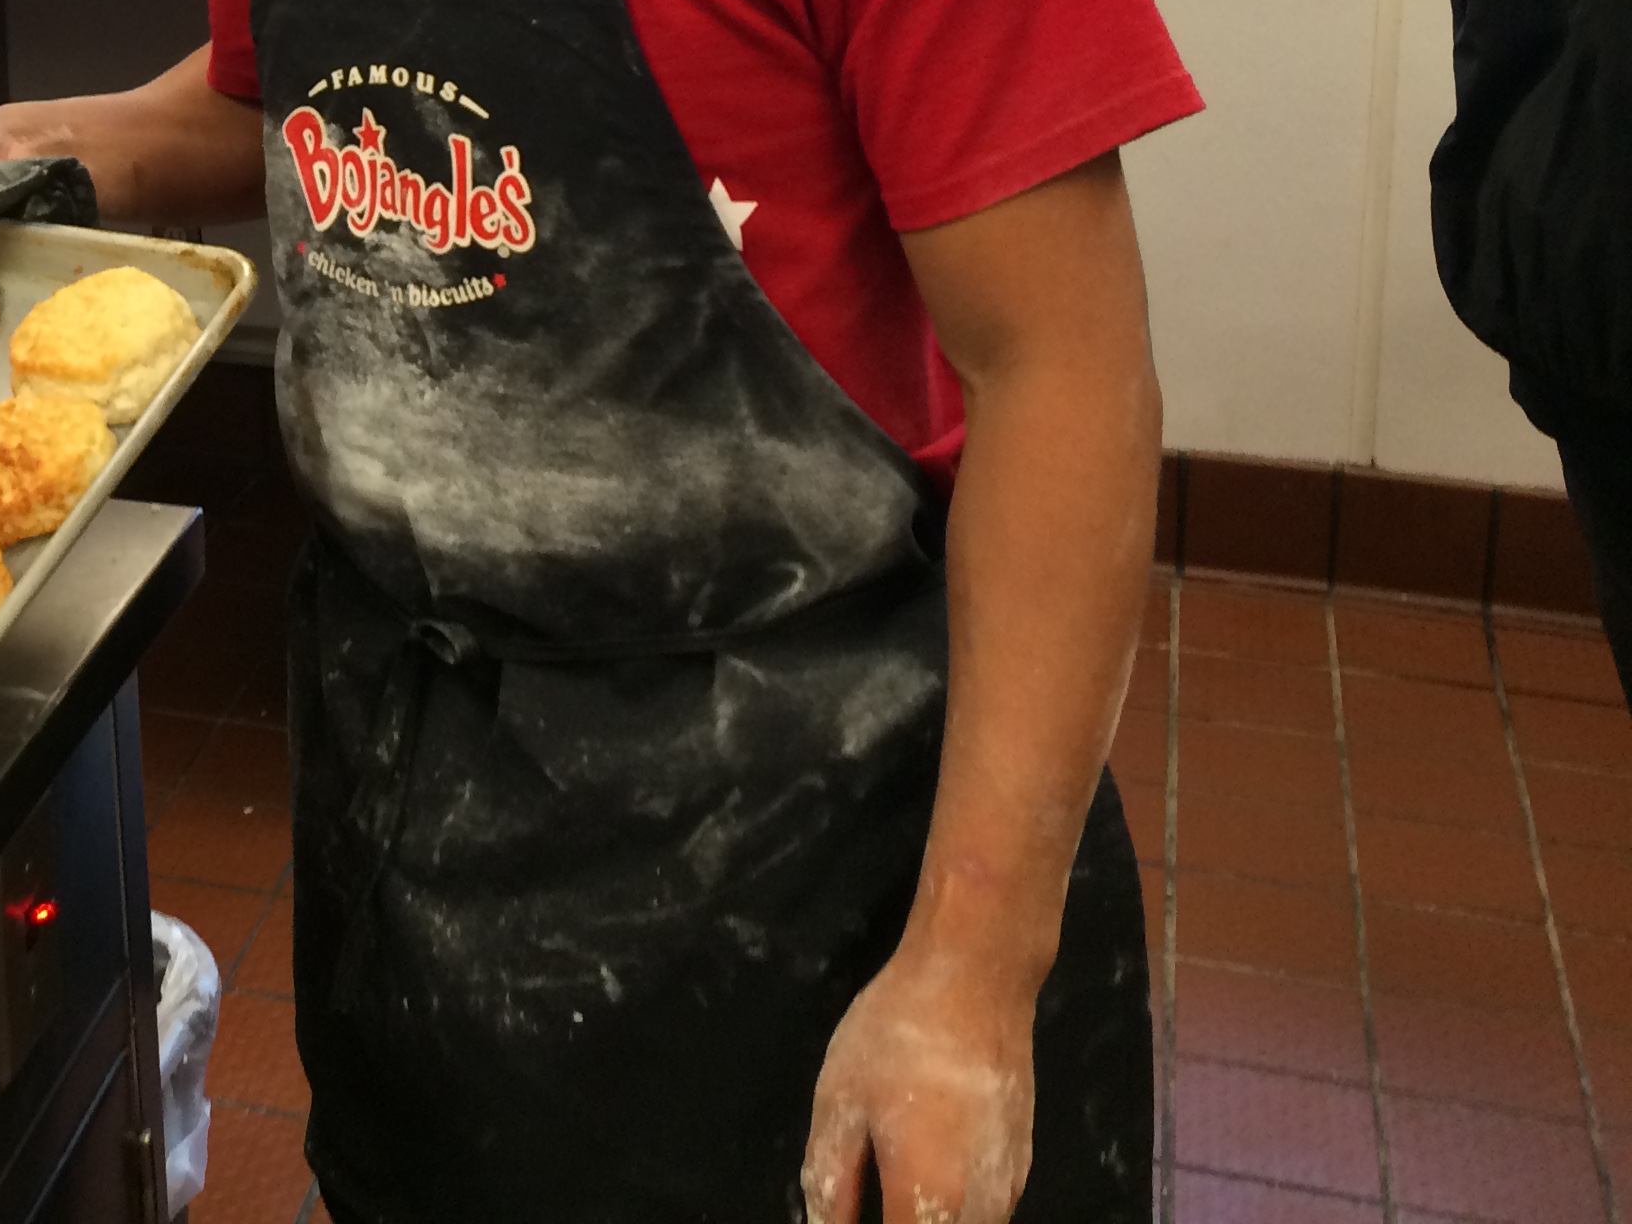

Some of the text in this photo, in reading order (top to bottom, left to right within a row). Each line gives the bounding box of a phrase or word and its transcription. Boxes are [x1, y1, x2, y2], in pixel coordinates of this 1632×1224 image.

[330, 64, 459, 102] FAMOUS
[308, 250, 379, 298] chicken
[407, 276, 495, 308] biscuits
